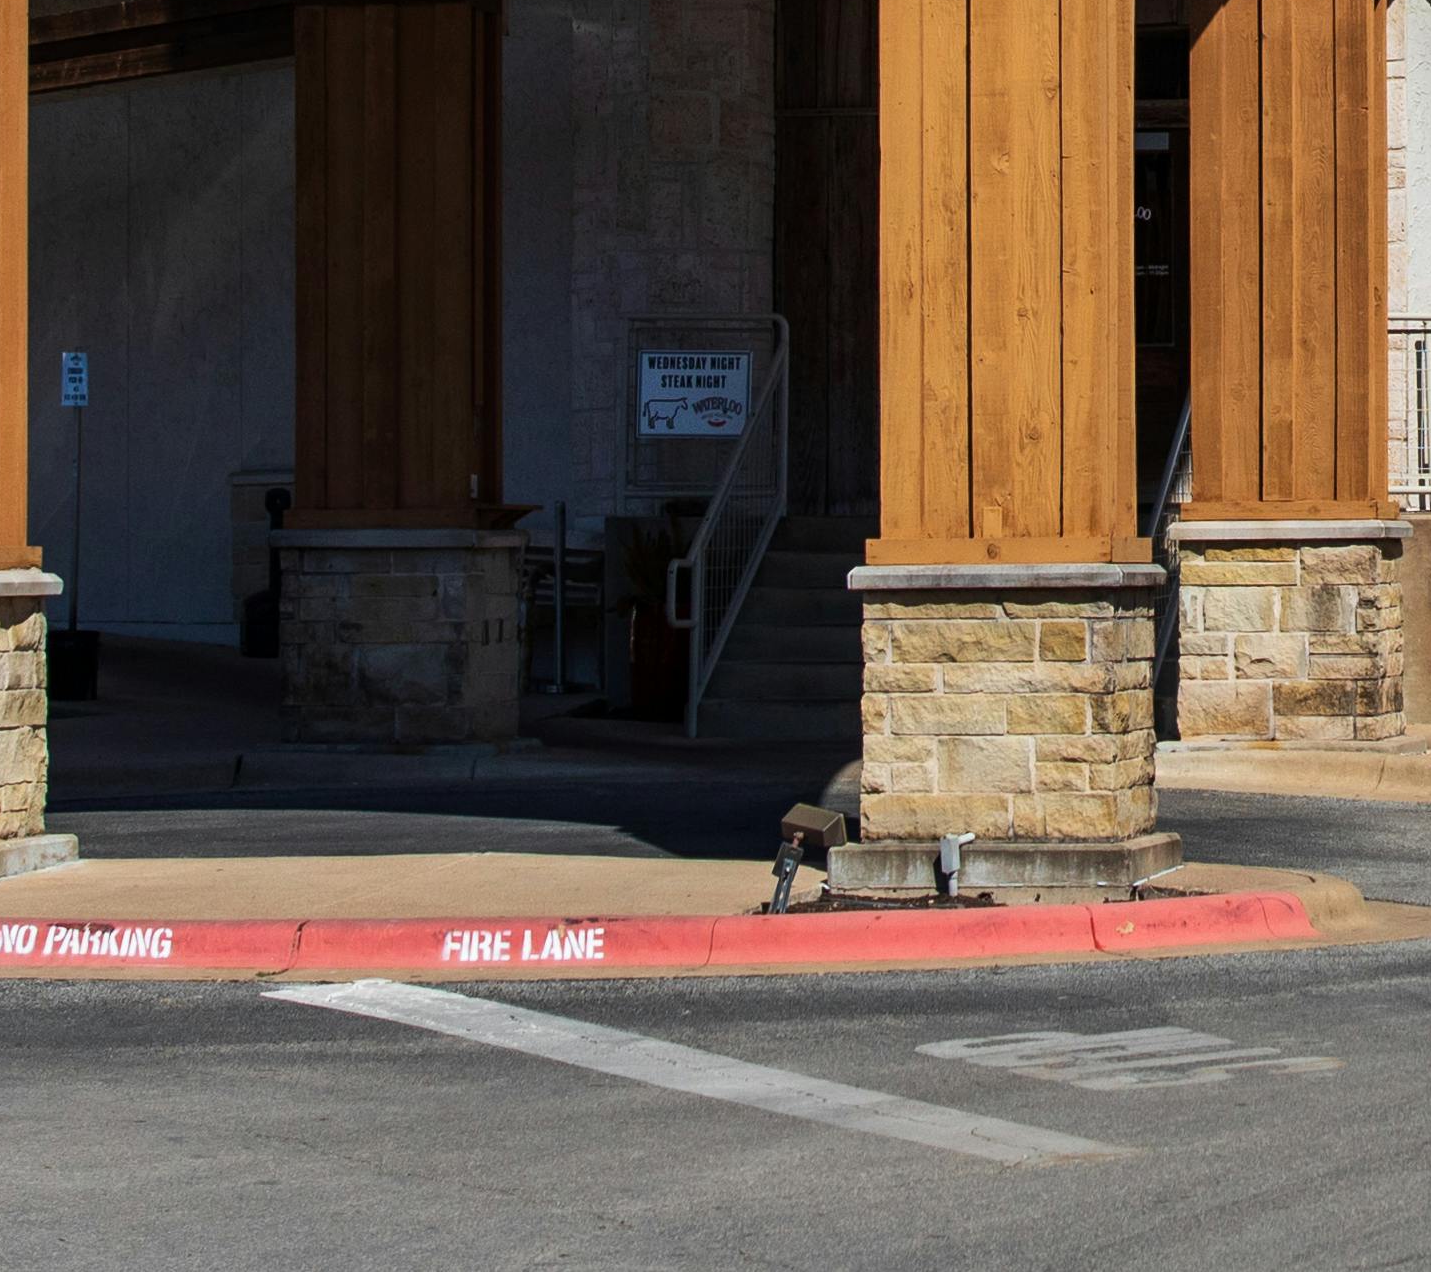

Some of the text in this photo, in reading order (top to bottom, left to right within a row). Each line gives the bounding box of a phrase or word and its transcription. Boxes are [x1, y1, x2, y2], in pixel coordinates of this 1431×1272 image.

[648, 356, 741, 370] WEDNESDAY NIGHT
[661, 375, 727, 388] STEAK NIGHT
[692, 396, 742, 415] WATERLOO
[42, 924, 173, 959] PARKING
[441, 928, 605, 962] FIRE LANE
